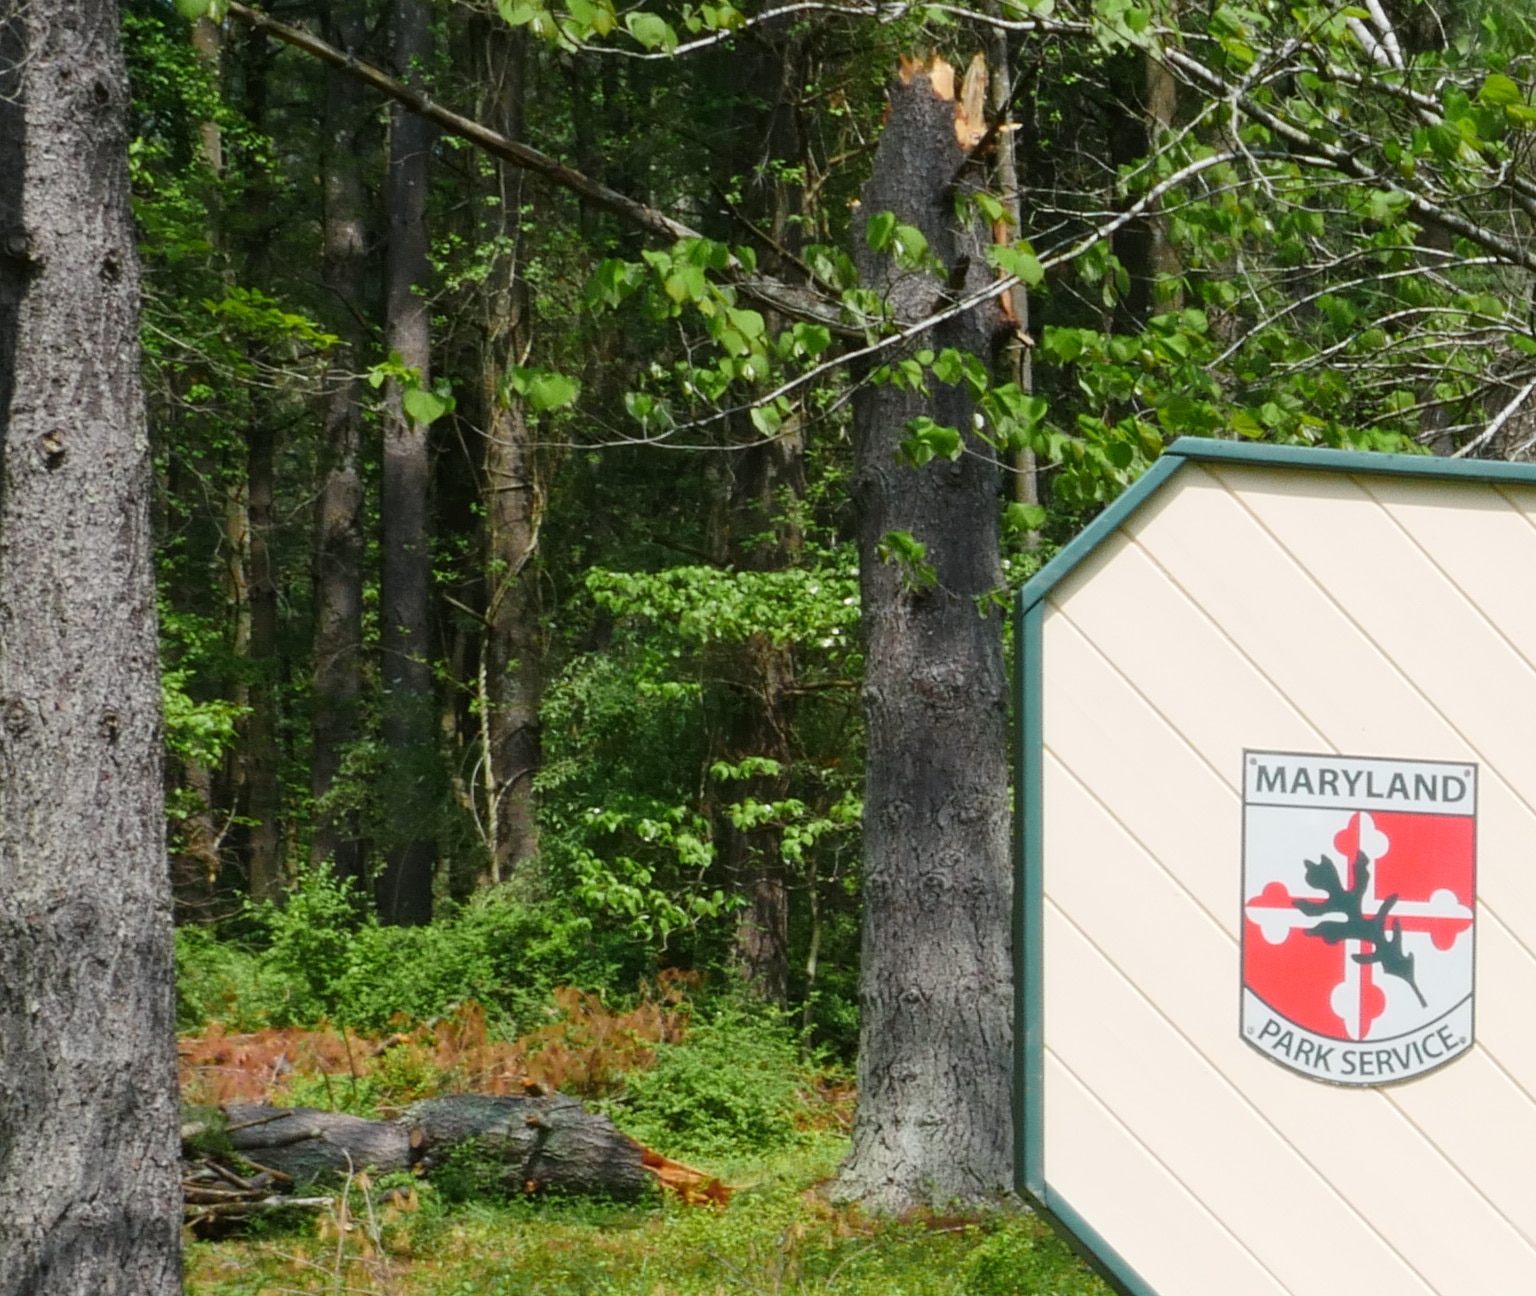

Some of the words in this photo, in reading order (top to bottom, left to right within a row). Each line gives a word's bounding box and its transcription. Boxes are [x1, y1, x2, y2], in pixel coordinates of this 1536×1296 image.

[1254, 764, 1468, 803] MARYLAND
[1257, 1017, 1336, 1073] PARK
[1340, 1023, 1460, 1077] SERVICE
